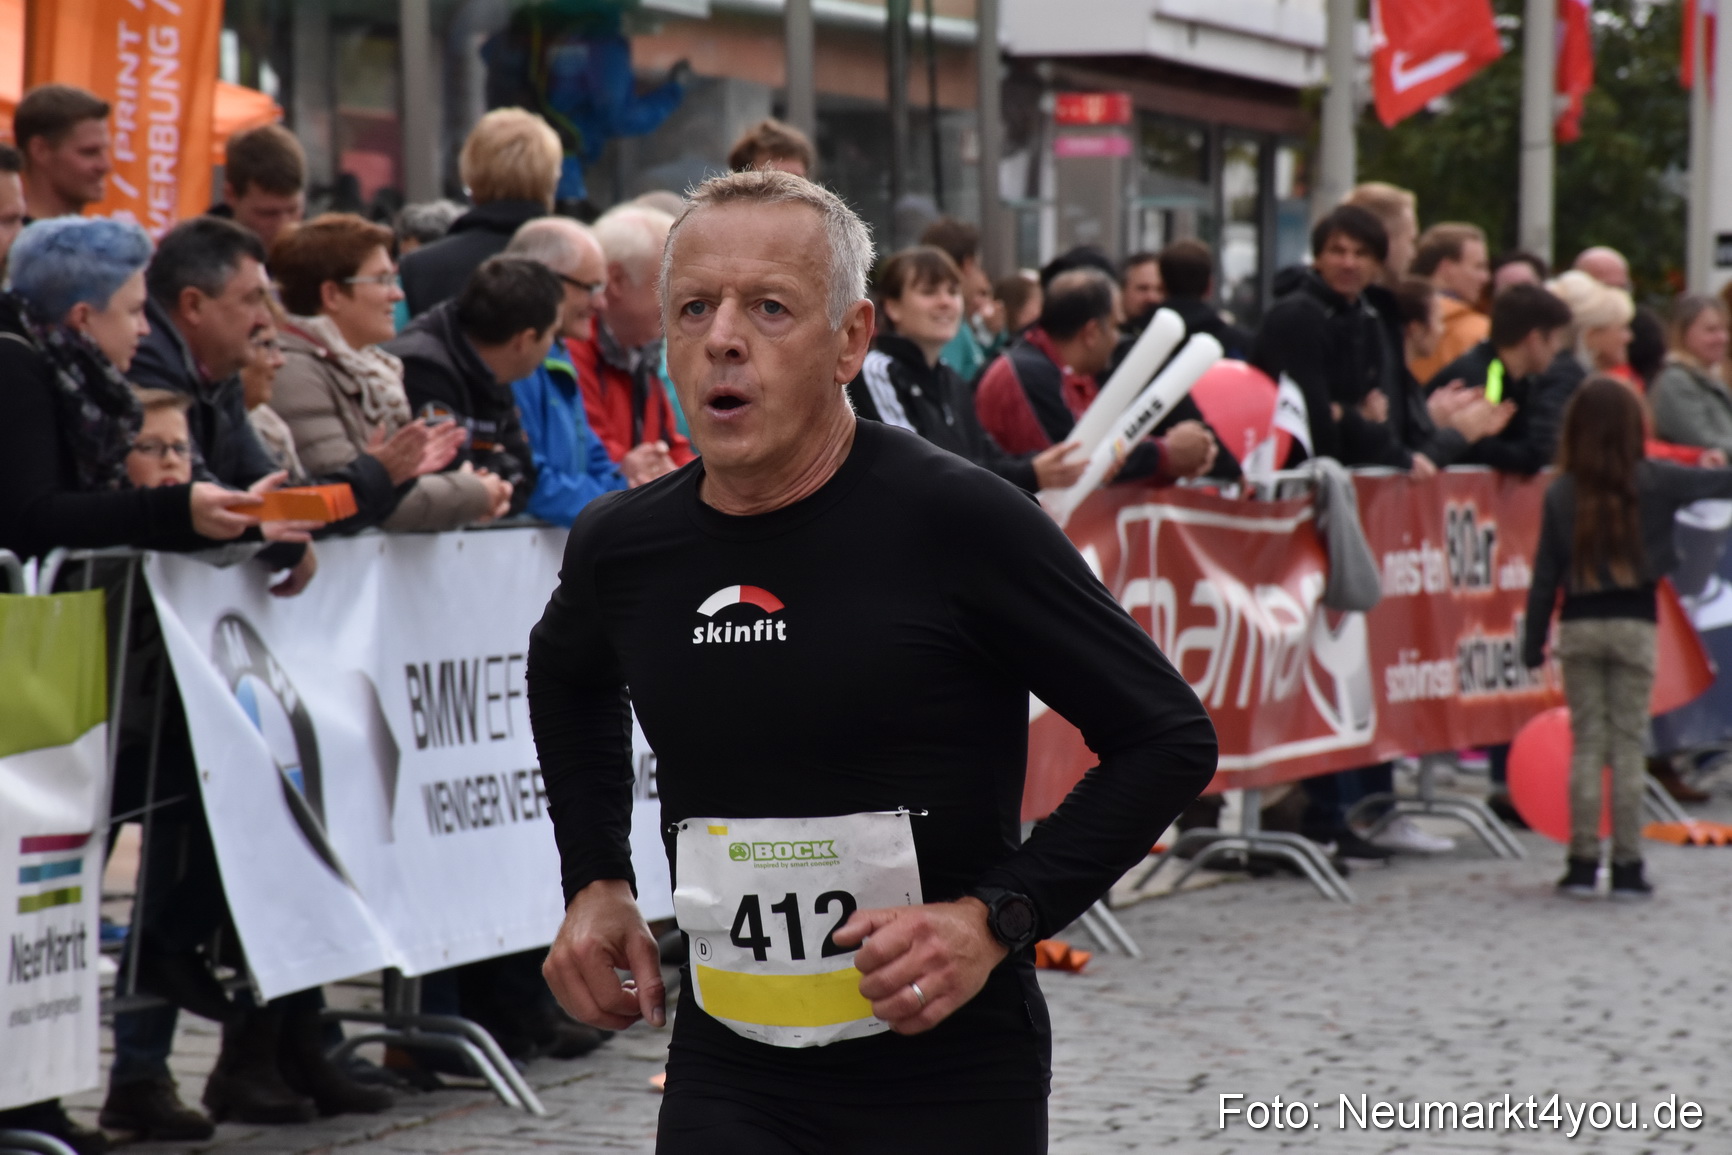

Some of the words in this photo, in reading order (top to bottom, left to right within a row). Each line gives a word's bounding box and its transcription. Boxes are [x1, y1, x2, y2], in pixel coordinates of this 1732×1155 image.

[114, 19, 143, 163] PRINT
[692, 618, 787, 645] skinfit
[752, 839, 839, 861] BOCK
[753, 862, 780, 870] inspired
[780, 861, 789, 869] by
[810, 859, 841, 868] concepts
[729, 889, 860, 962] 412
